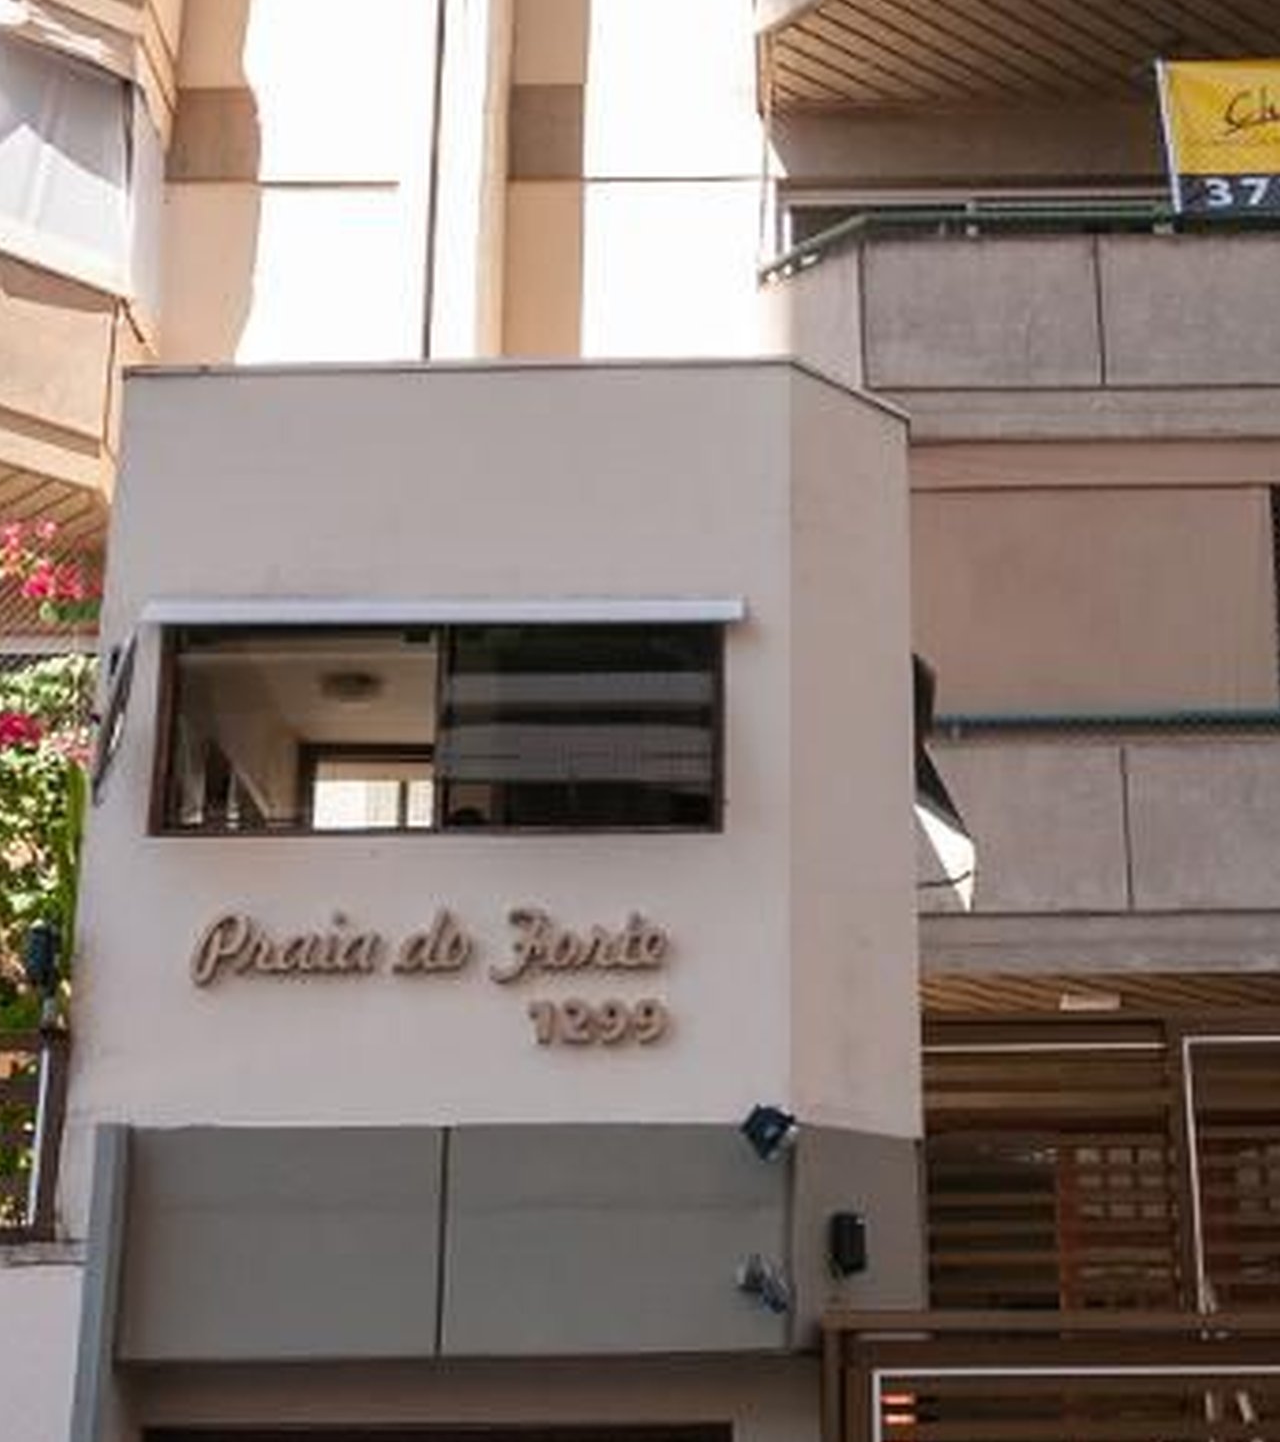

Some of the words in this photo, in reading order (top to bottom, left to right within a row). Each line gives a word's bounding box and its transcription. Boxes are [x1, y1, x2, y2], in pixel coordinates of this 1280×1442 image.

[192, 911, 381, 987] Praia
[392, 912, 474, 975] do
[490, 910, 668, 984] Forte
[528, 1000, 668, 1045] 1299
